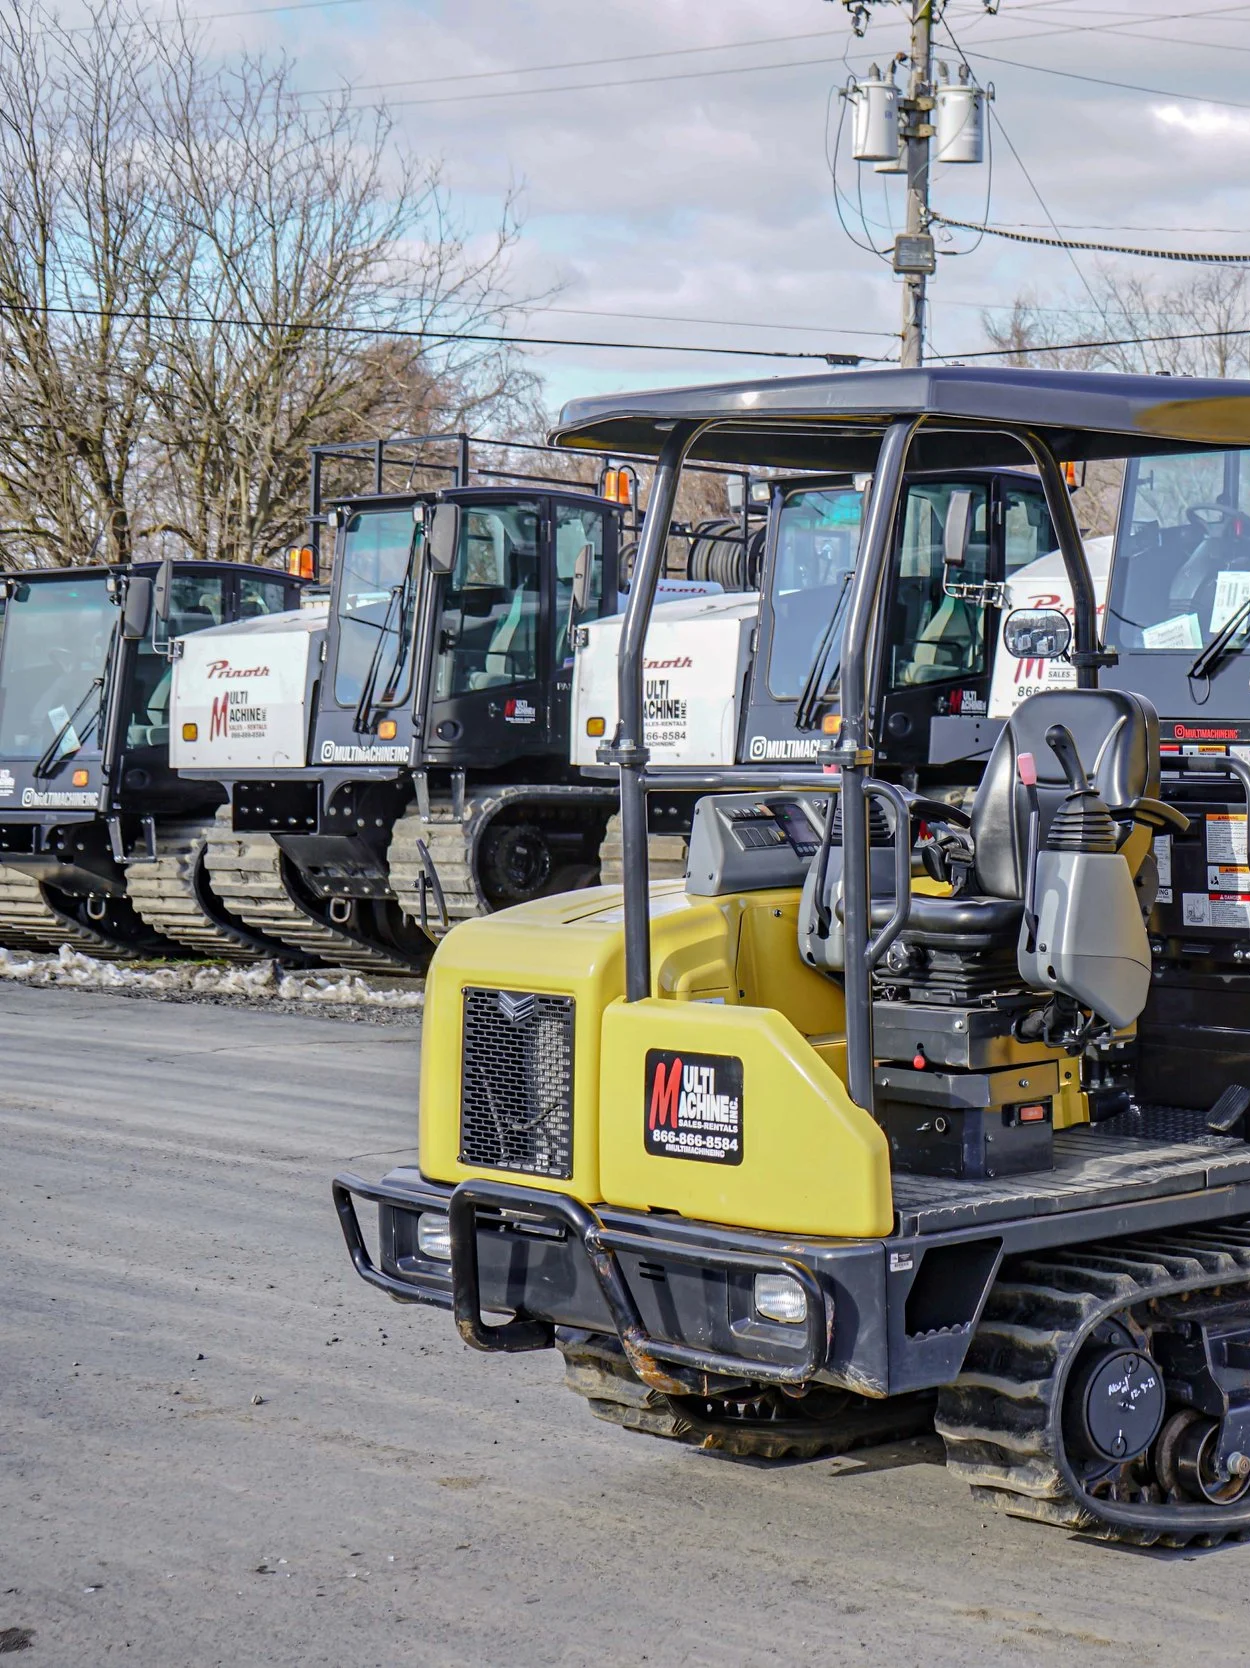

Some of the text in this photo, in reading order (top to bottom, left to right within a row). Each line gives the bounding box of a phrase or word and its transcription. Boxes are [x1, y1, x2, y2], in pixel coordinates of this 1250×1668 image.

[206, 660, 270, 679] Prinoth
[643, 657, 693, 669] inoth
[646, 731, 686, 741] 66-8584
[1185, 727, 1239, 740] MULTIMACHINEINC
[334, 744, 410, 763] MULTIMACHINEINC
[729, 1097, 738, 1124] INC.
[678, 1119, 738, 1133] SALES-RENTALS
[652, 1129, 739, 1151] 866-866-8584
